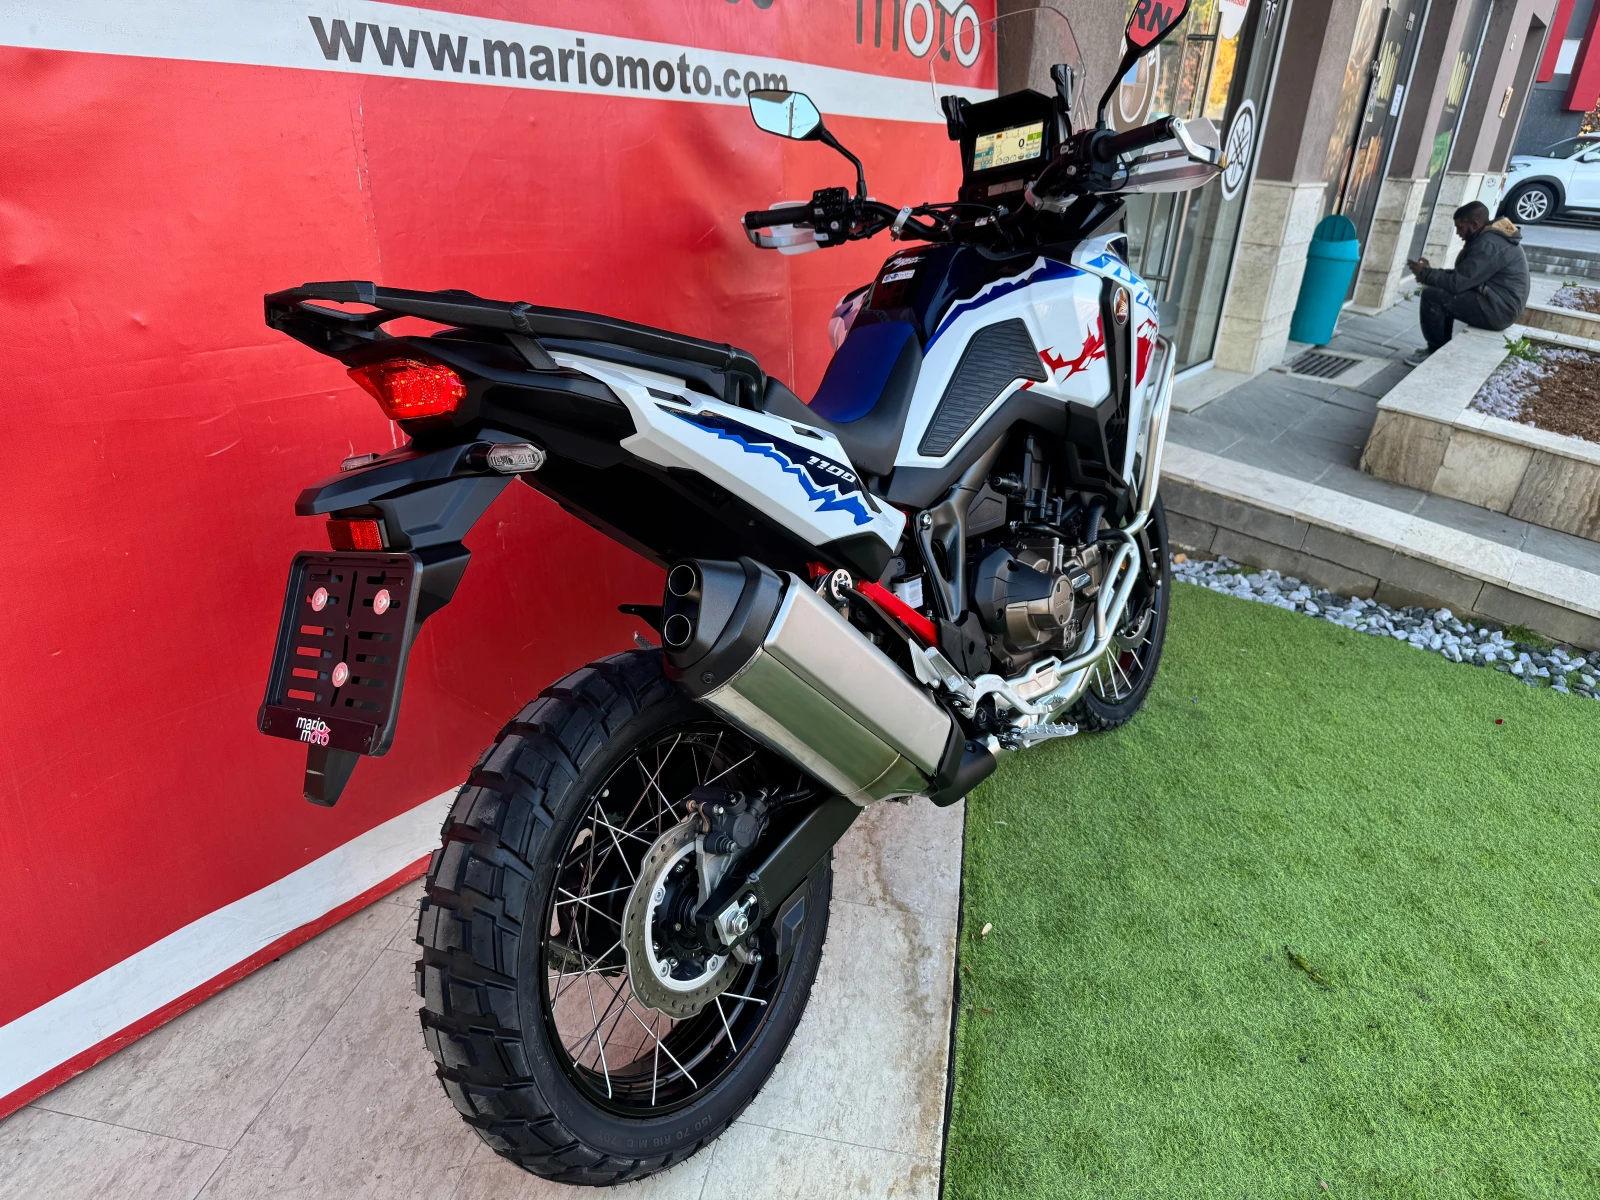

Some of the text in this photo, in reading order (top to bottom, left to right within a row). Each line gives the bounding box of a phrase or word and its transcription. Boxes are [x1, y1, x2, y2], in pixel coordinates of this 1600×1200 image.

[308, 16, 788, 97] www.mariomoto.com
[806, 455, 857, 483] 1100
[296, 717, 326, 732] mario
[300, 730, 330, 746] moto
[653, 1134, 671, 1148] R18
